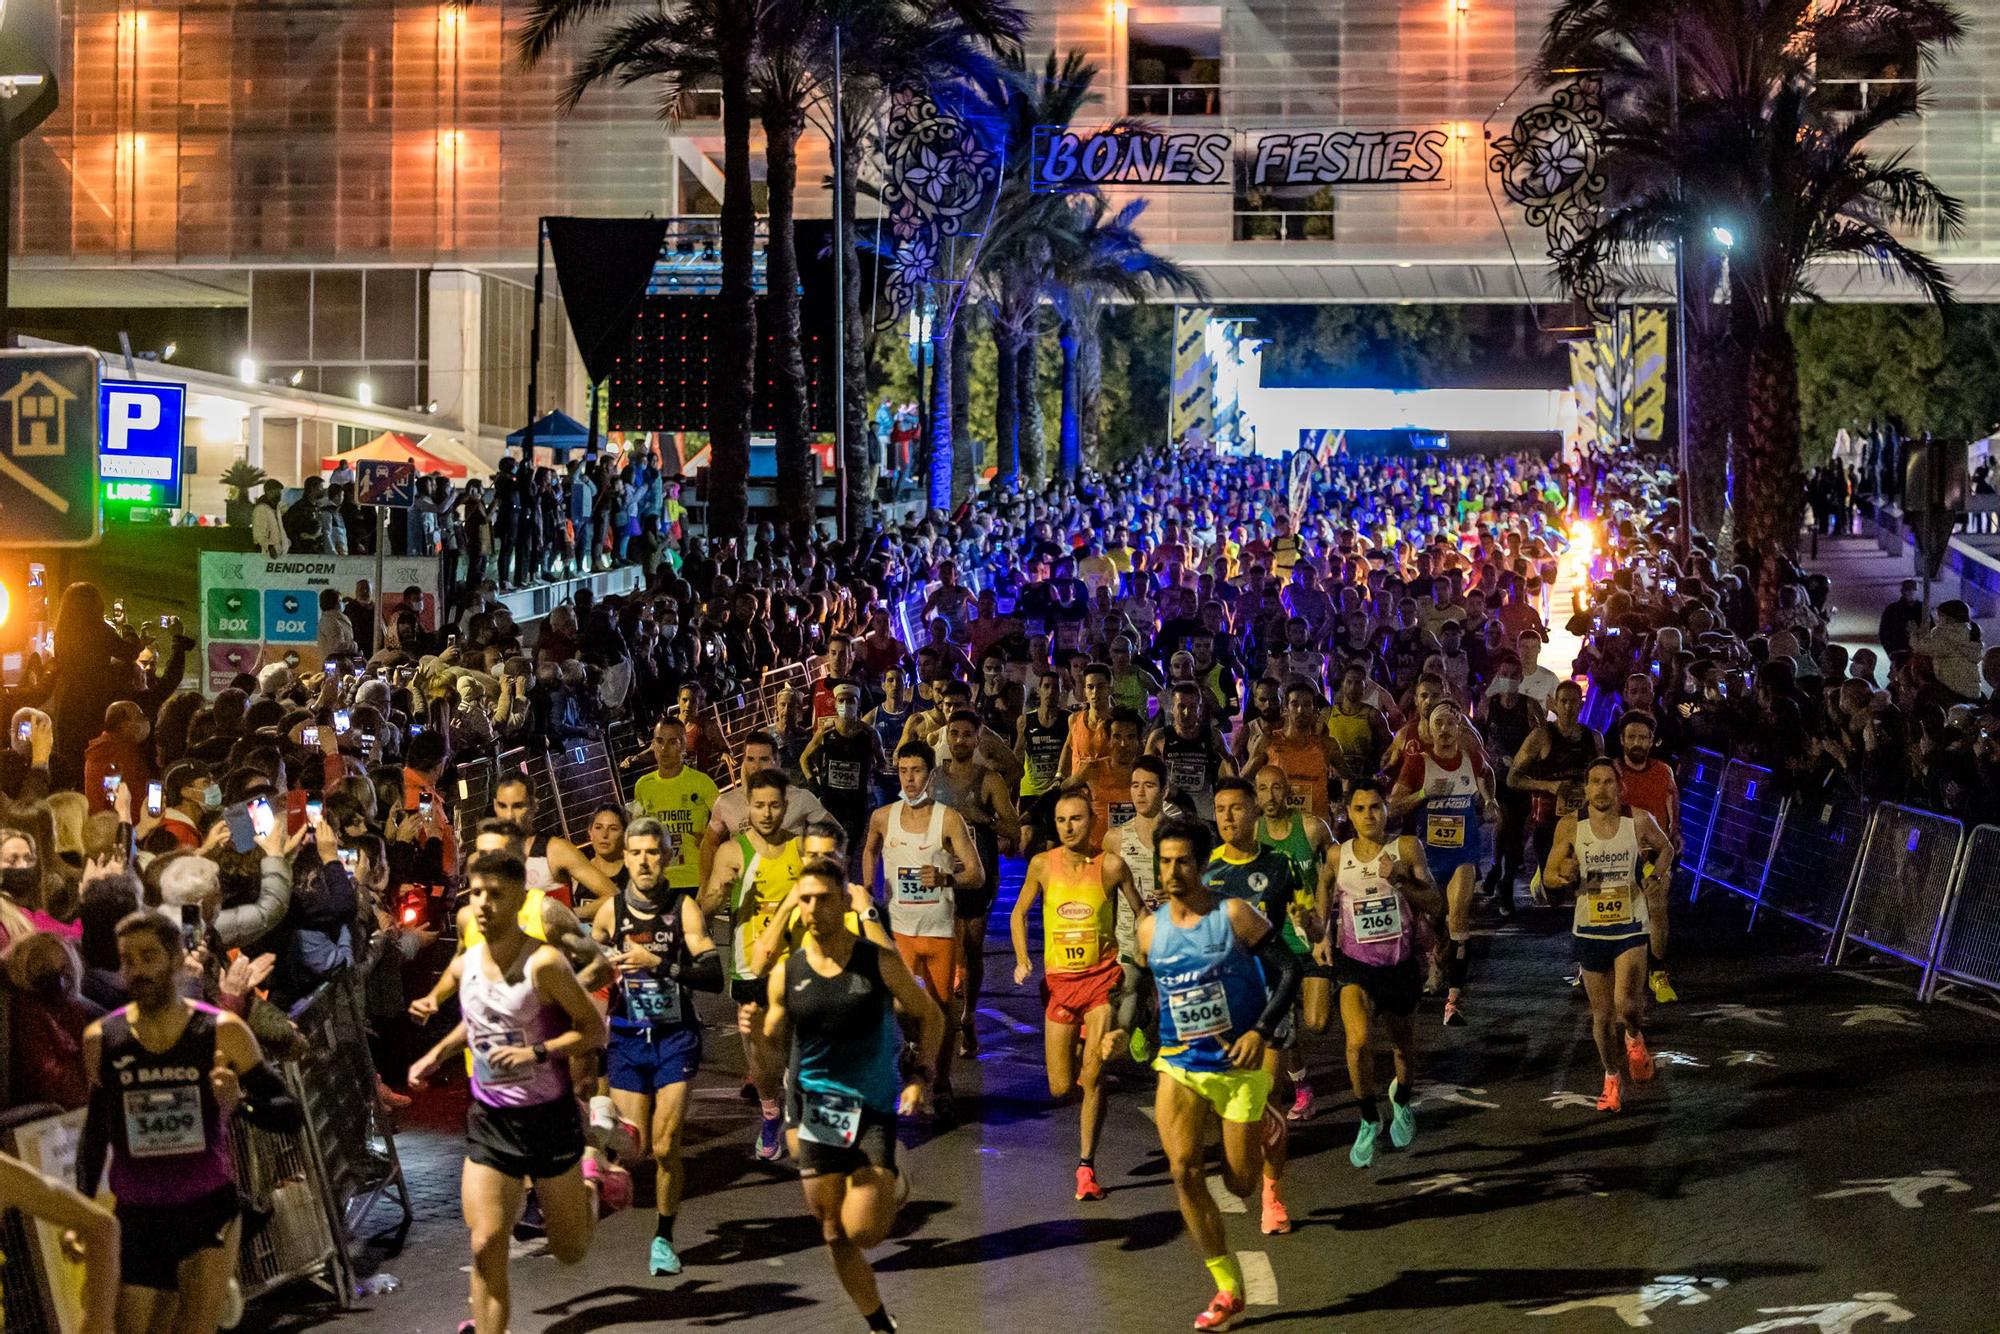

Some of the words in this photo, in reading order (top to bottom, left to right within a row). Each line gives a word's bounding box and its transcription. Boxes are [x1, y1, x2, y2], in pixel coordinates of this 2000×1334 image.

[1042, 132, 1232, 184] BONES
[1255, 131, 1449, 183] FESTES
[107, 391, 161, 450] P
[266, 562, 336, 574] BENIDORM
[218, 618, 249, 632] BOX
[276, 620, 306, 633] BOX
[1435, 829, 1457, 838] 437
[1585, 851, 1629, 866] Evedeport
[1596, 901, 1622, 912] 849
[1361, 914, 1393, 930] 2166
[655, 931, 674, 943] CN
[1065, 947, 1085, 960] 119
[634, 996, 674, 1012] 3362
[1179, 1003, 1223, 1024] 3606
[138, 1066, 200, 1082] BARCO
